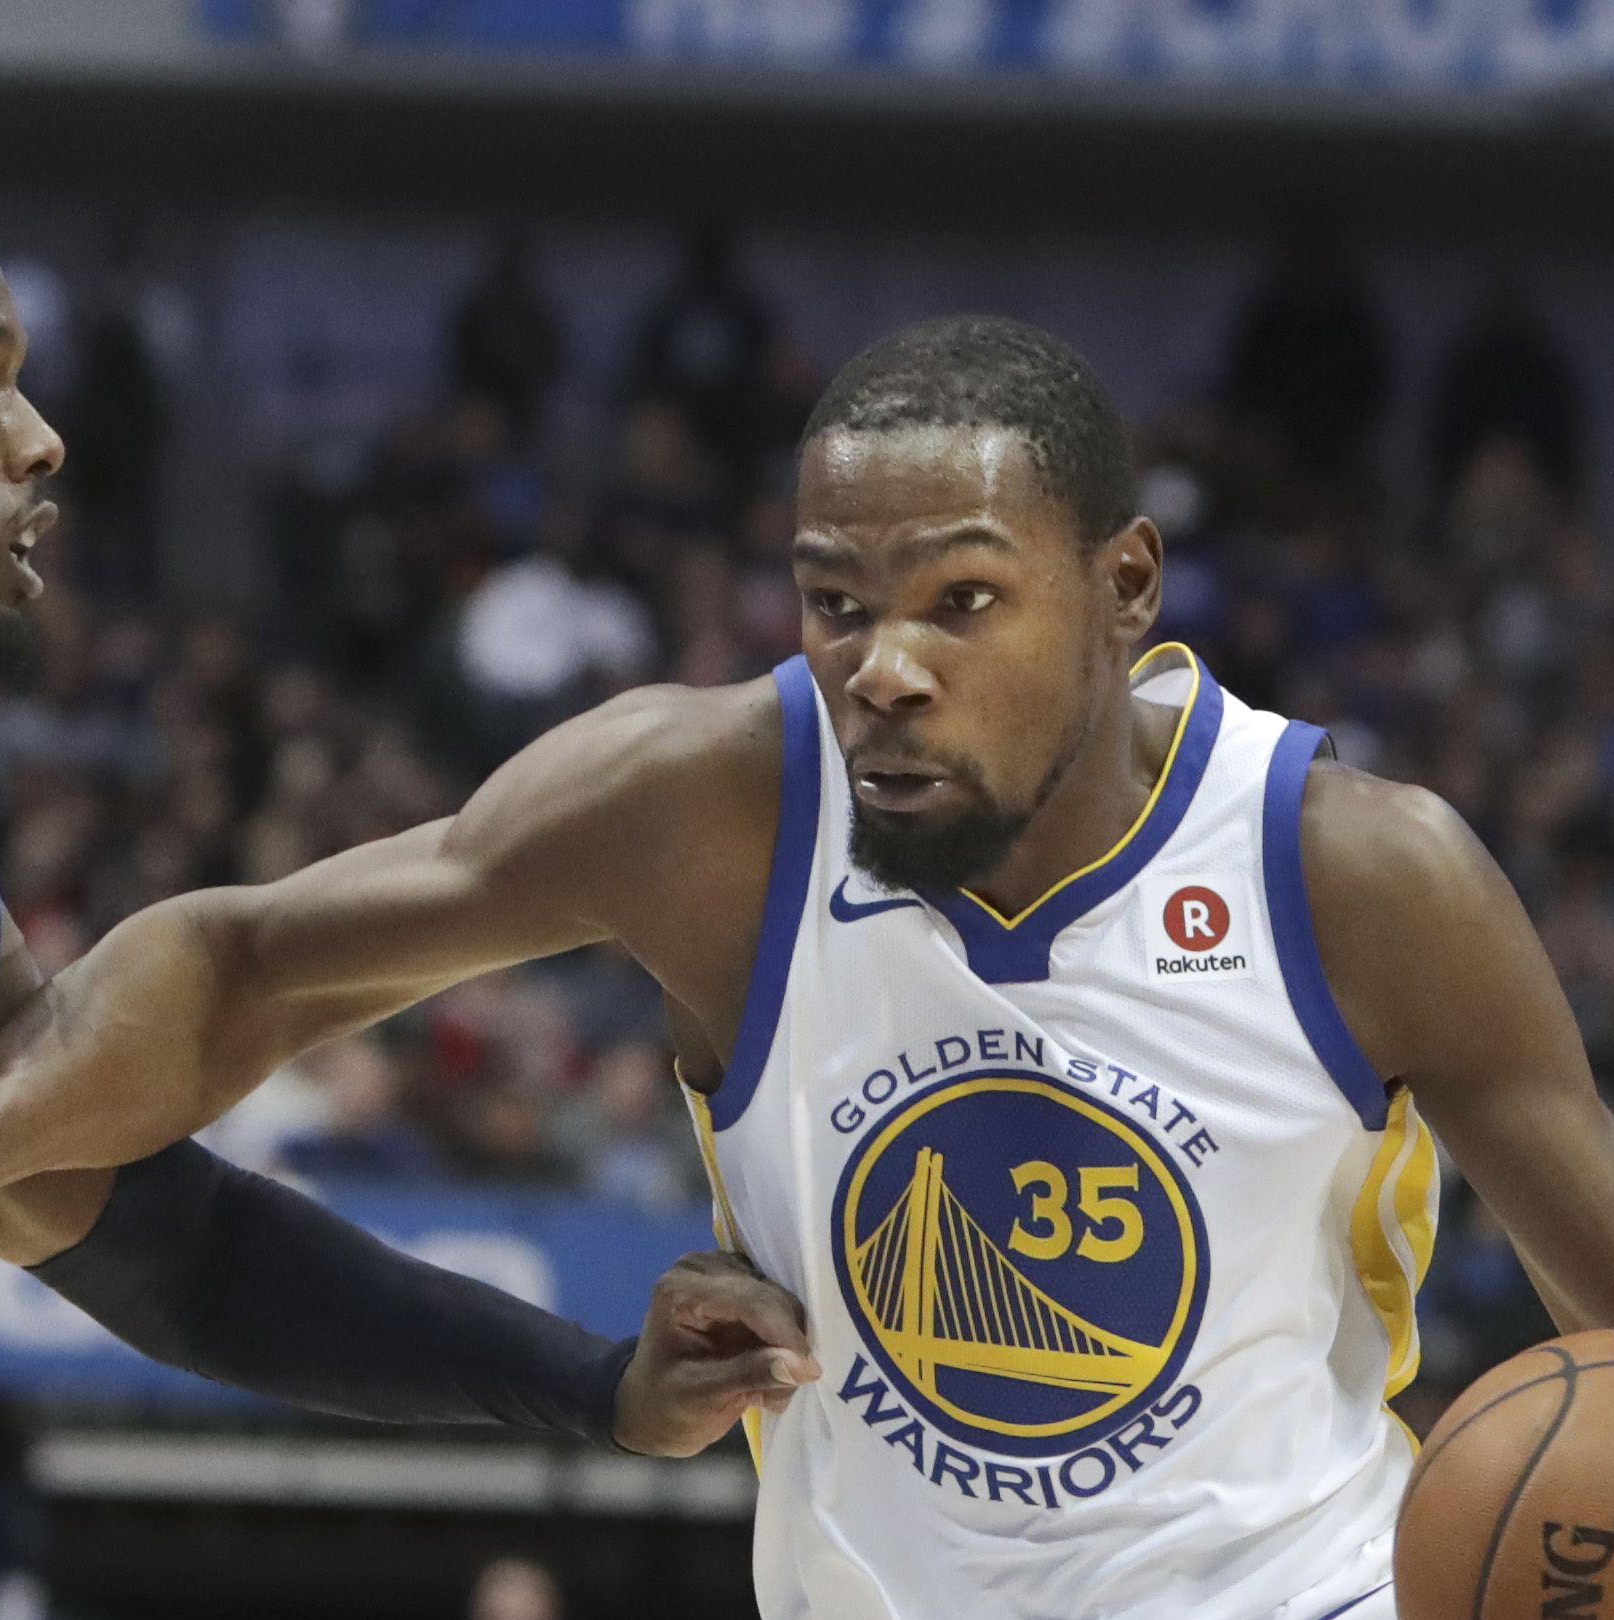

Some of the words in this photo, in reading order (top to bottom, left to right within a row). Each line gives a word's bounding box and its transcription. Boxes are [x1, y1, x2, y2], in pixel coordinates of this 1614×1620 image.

[1156, 955, 1246, 975] Rakuten
[1182, 900, 1216, 938] R
[830, 1029, 1044, 1135] GOLDEN
[1067, 1058, 1220, 1167] STATE
[1008, 1161, 1145, 1263] 35
[836, 1352, 1204, 1509] WARRIORS
